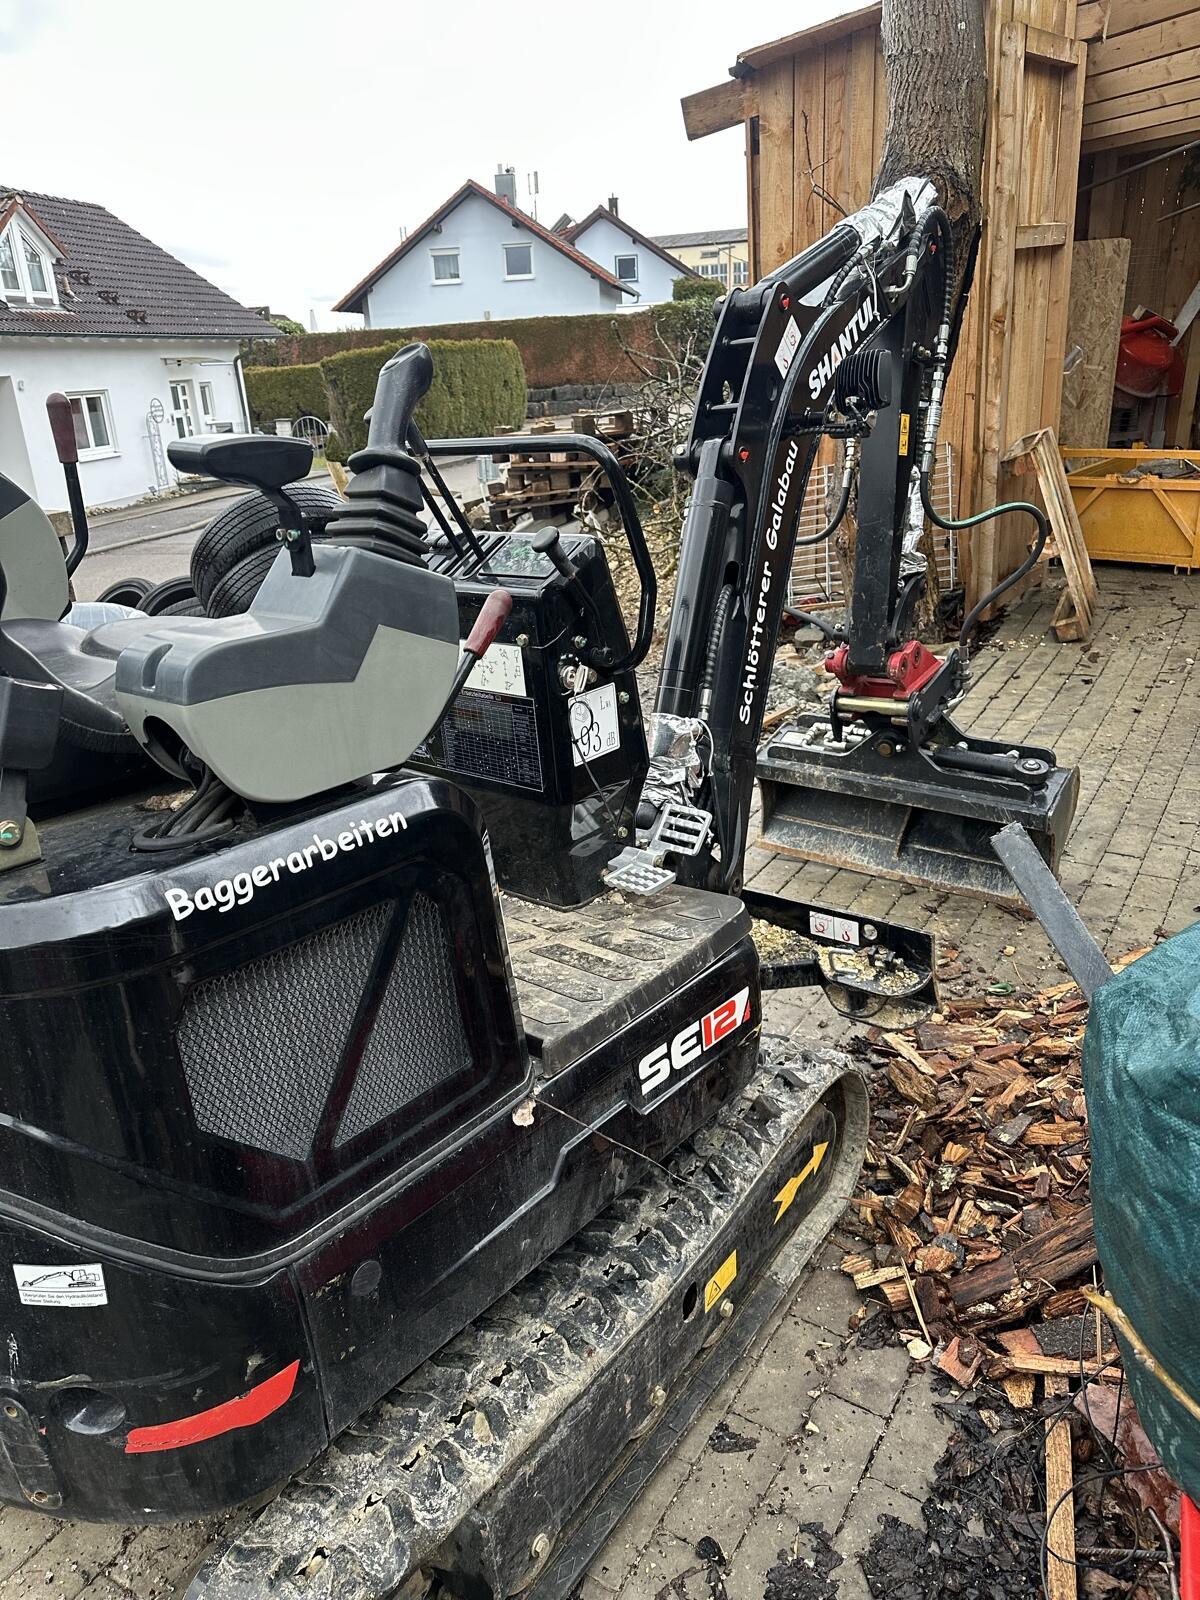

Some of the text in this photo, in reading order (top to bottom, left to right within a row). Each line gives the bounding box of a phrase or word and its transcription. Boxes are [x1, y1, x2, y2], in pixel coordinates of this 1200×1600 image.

[809, 296, 873, 400] SHANTUI
[740, 440, 798, 725] Schlötterer Galabau
[581, 721, 602, 757] 93
[164, 811, 408, 921] Baggerarbeiten
[638, 999, 738, 1096] SE12
